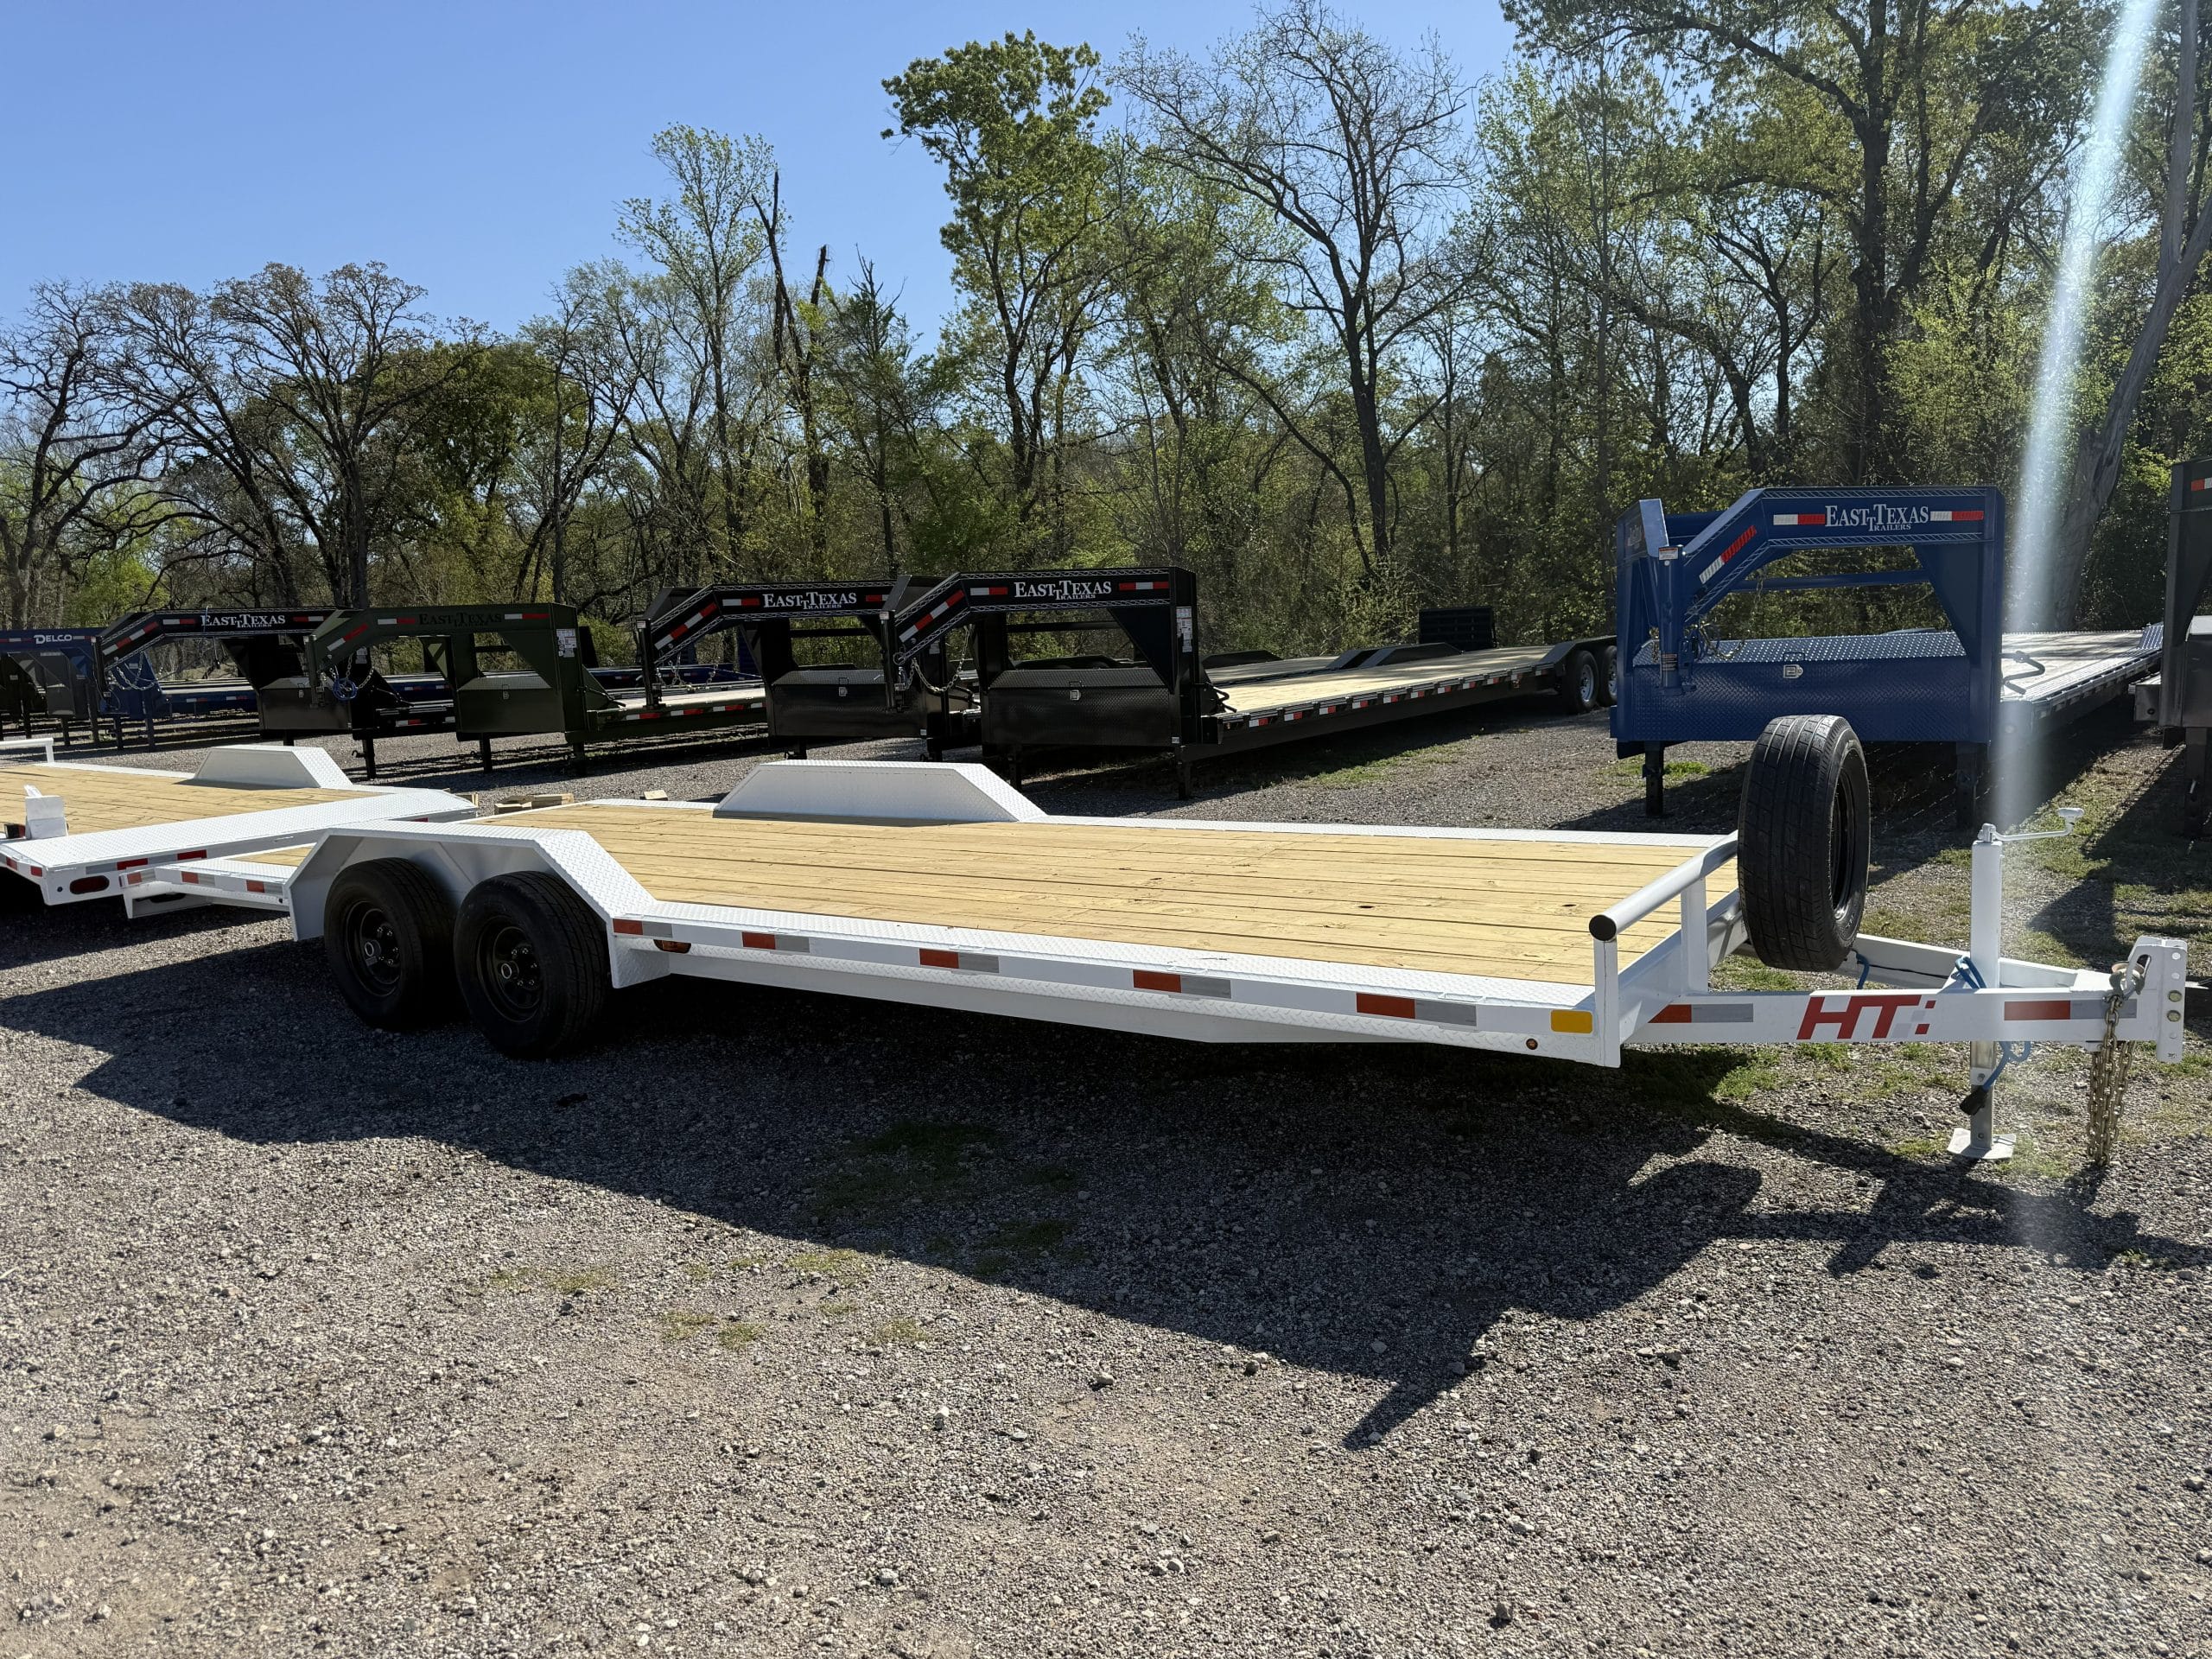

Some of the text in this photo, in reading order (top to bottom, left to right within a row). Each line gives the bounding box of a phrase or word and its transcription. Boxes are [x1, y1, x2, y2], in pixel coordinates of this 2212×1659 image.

[1824, 504, 1929, 527] EAST TEXAS
[1866, 517, 1911, 531] TRAILERS
[1014, 580, 1112, 598] EAST TEXAS
[1053, 589, 1096, 601] TRAILERS
[762, 592, 857, 608] EAST TEXAS
[200, 613, 286, 626] EAST TEXAS
[418, 613, 454, 625] EAST
[456, 612, 502, 623] TEXAS
[34, 634, 73, 645] DELCO
